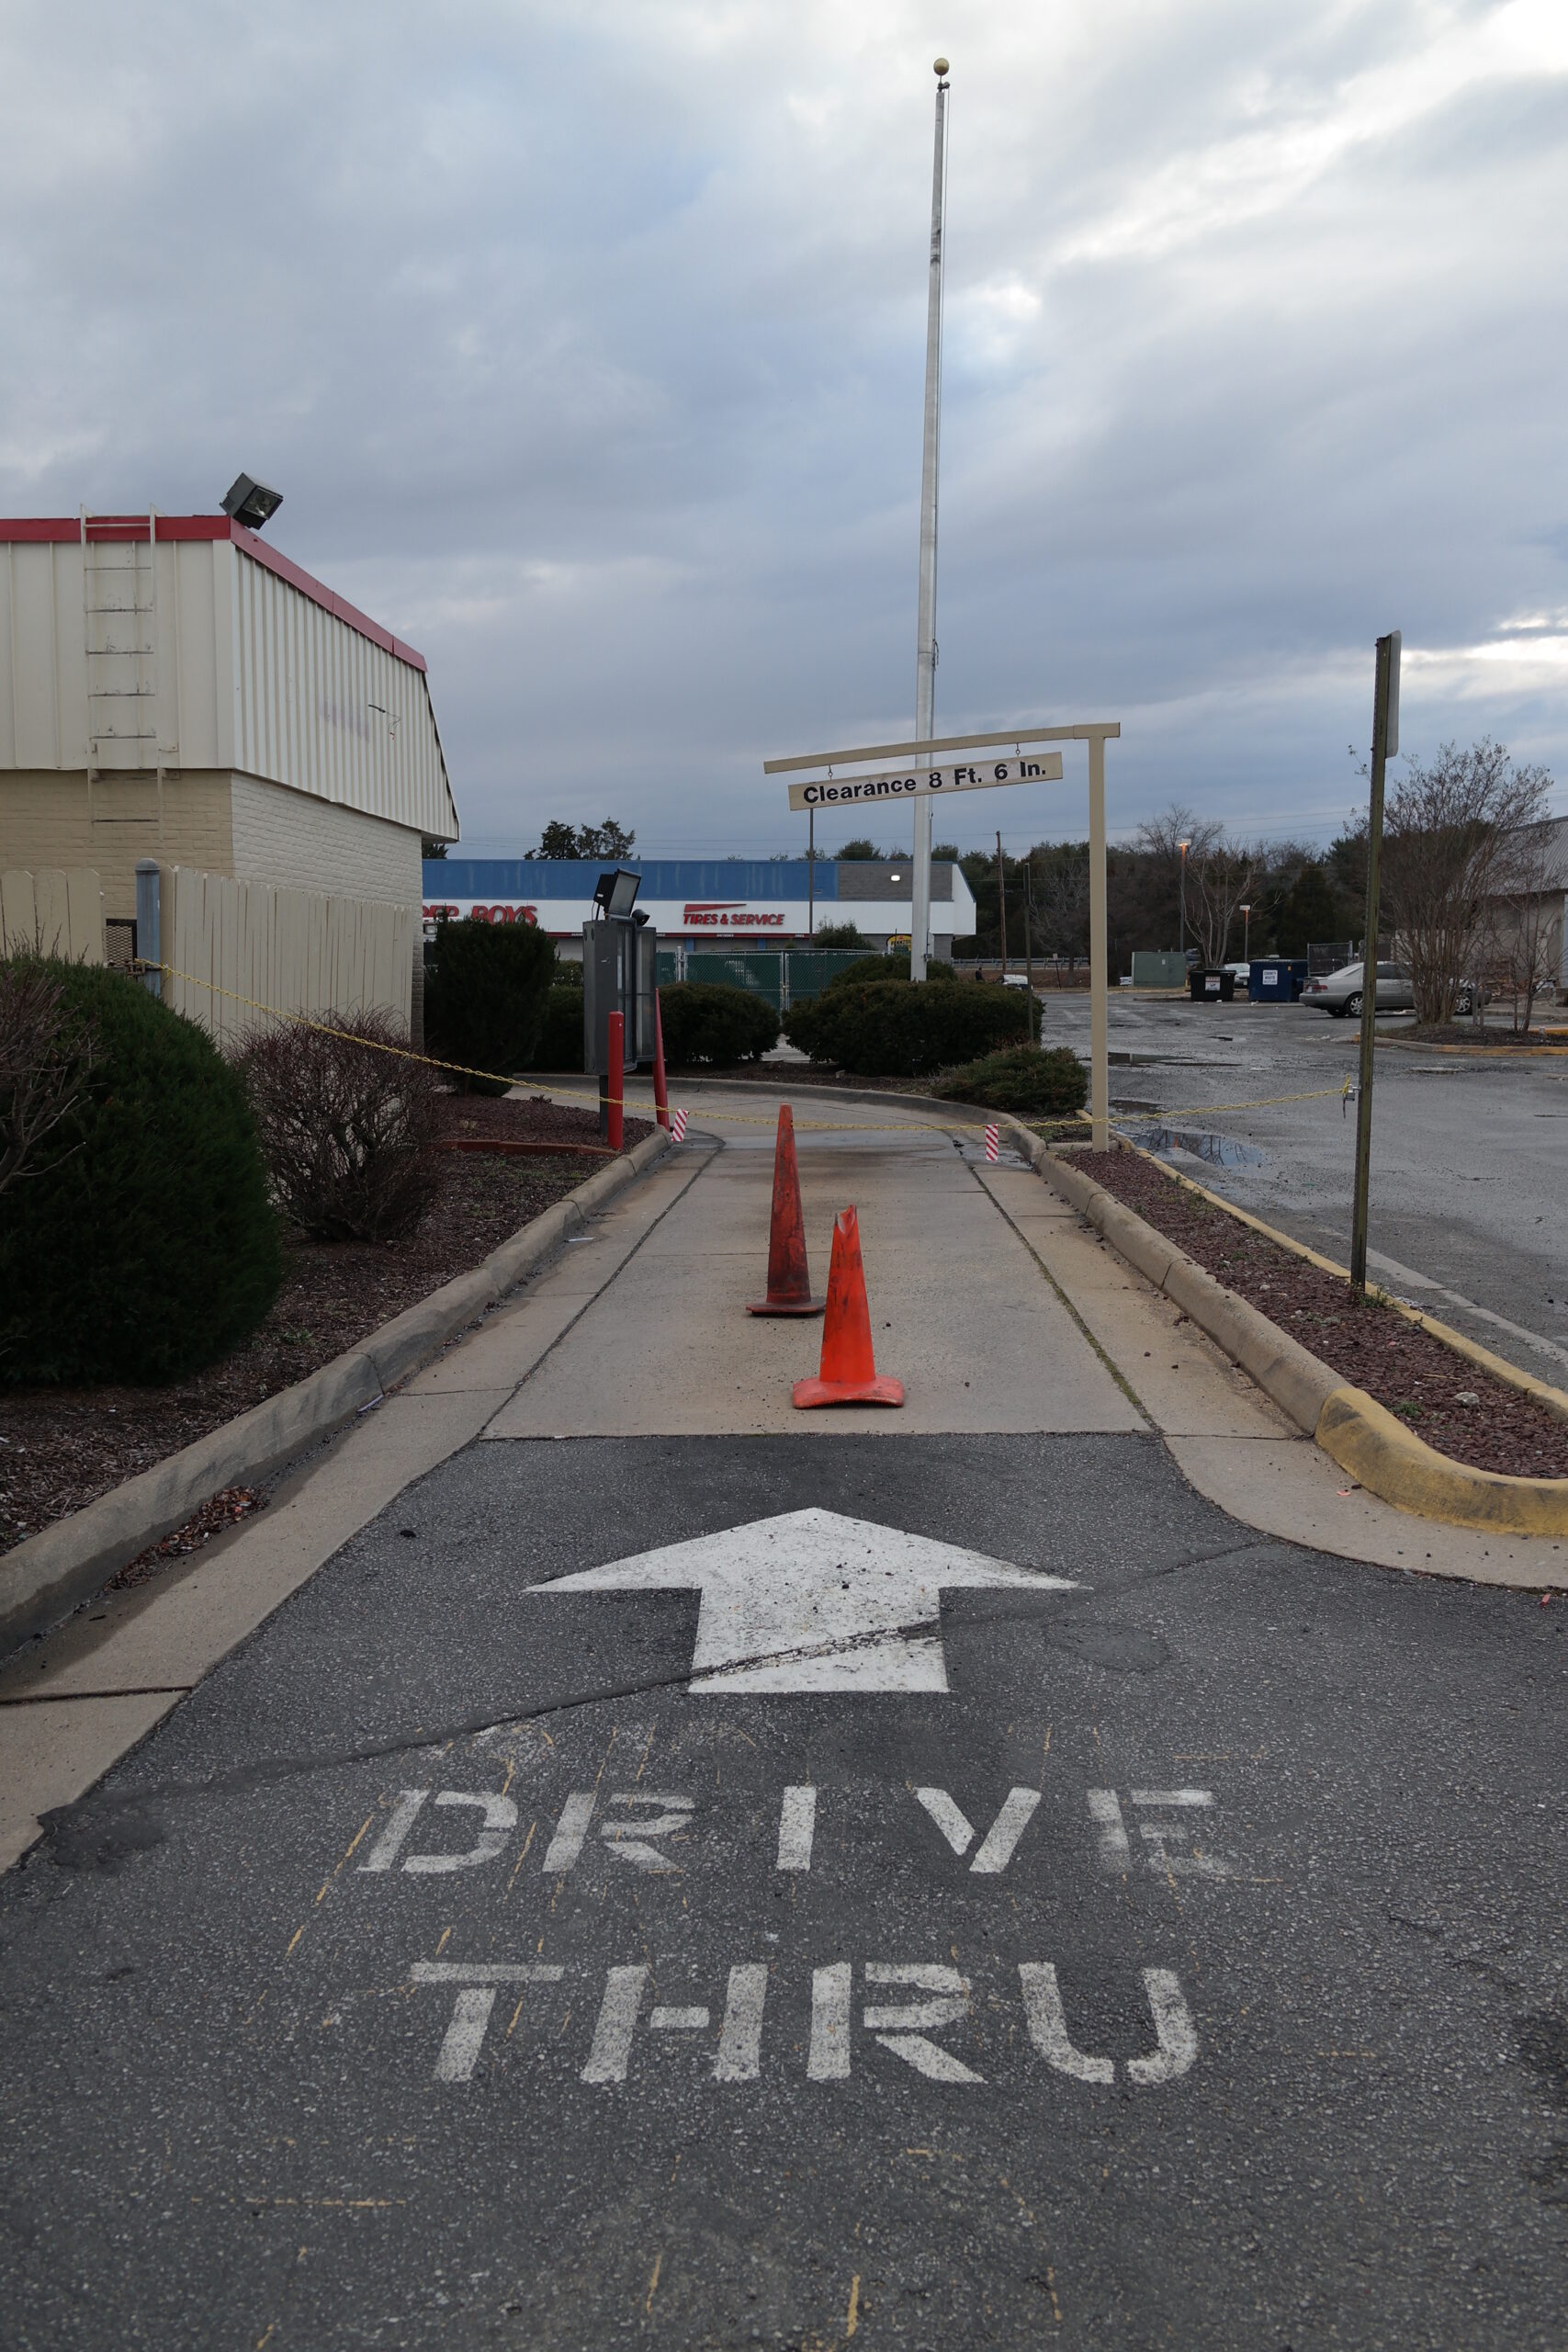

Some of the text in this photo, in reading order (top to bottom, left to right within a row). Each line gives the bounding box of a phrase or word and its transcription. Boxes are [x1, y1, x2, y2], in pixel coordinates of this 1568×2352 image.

[803, 761, 1046, 804] Clearance 8 Ft. 6 In.
[682, 913, 785, 926] TIRES & SERVICE
[357, 1786, 1236, 1875] DRIVE
[410, 1961, 1199, 2085] THRU
